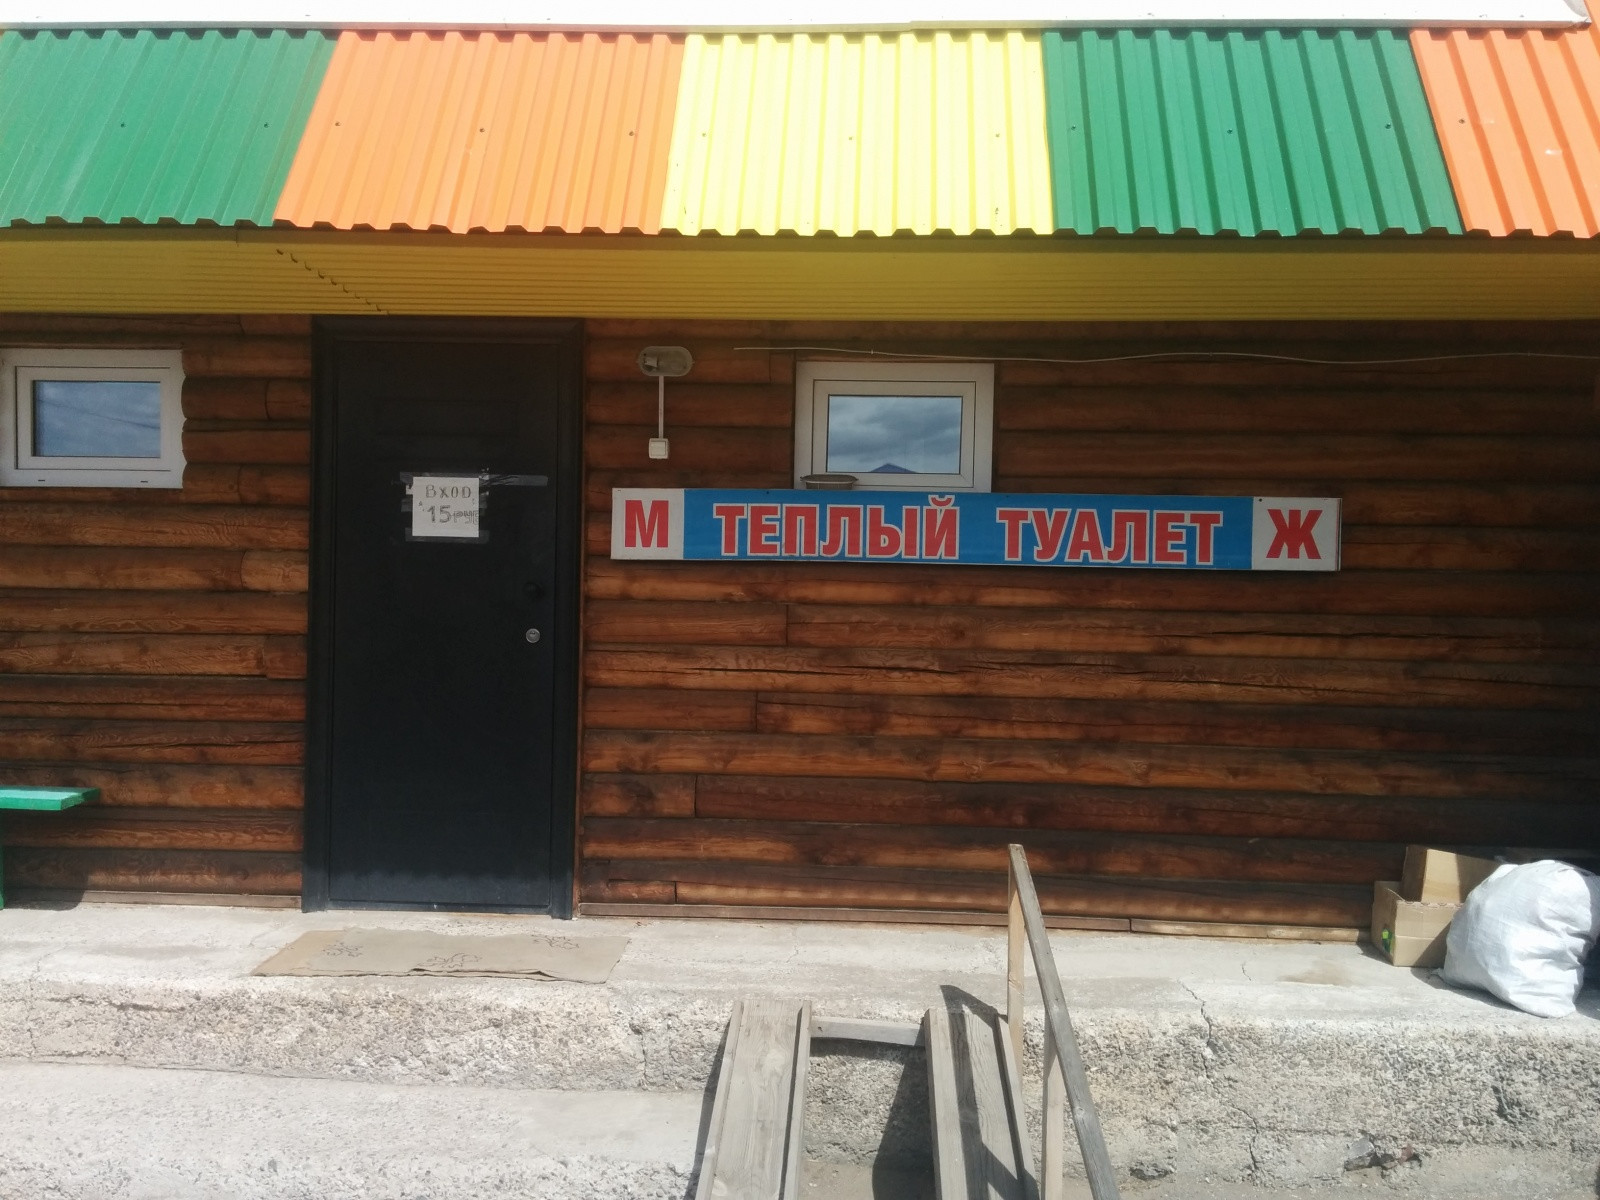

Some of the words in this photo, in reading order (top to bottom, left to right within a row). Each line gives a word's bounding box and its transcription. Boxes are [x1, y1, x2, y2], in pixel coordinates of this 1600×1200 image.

[624, 499, 669, 548] М
[713, 494, 960, 560] ТЕПЛЫЙ
[996, 507, 1224, 566] ТУАЛЕТ
[1266, 508, 1323, 560] Ж
